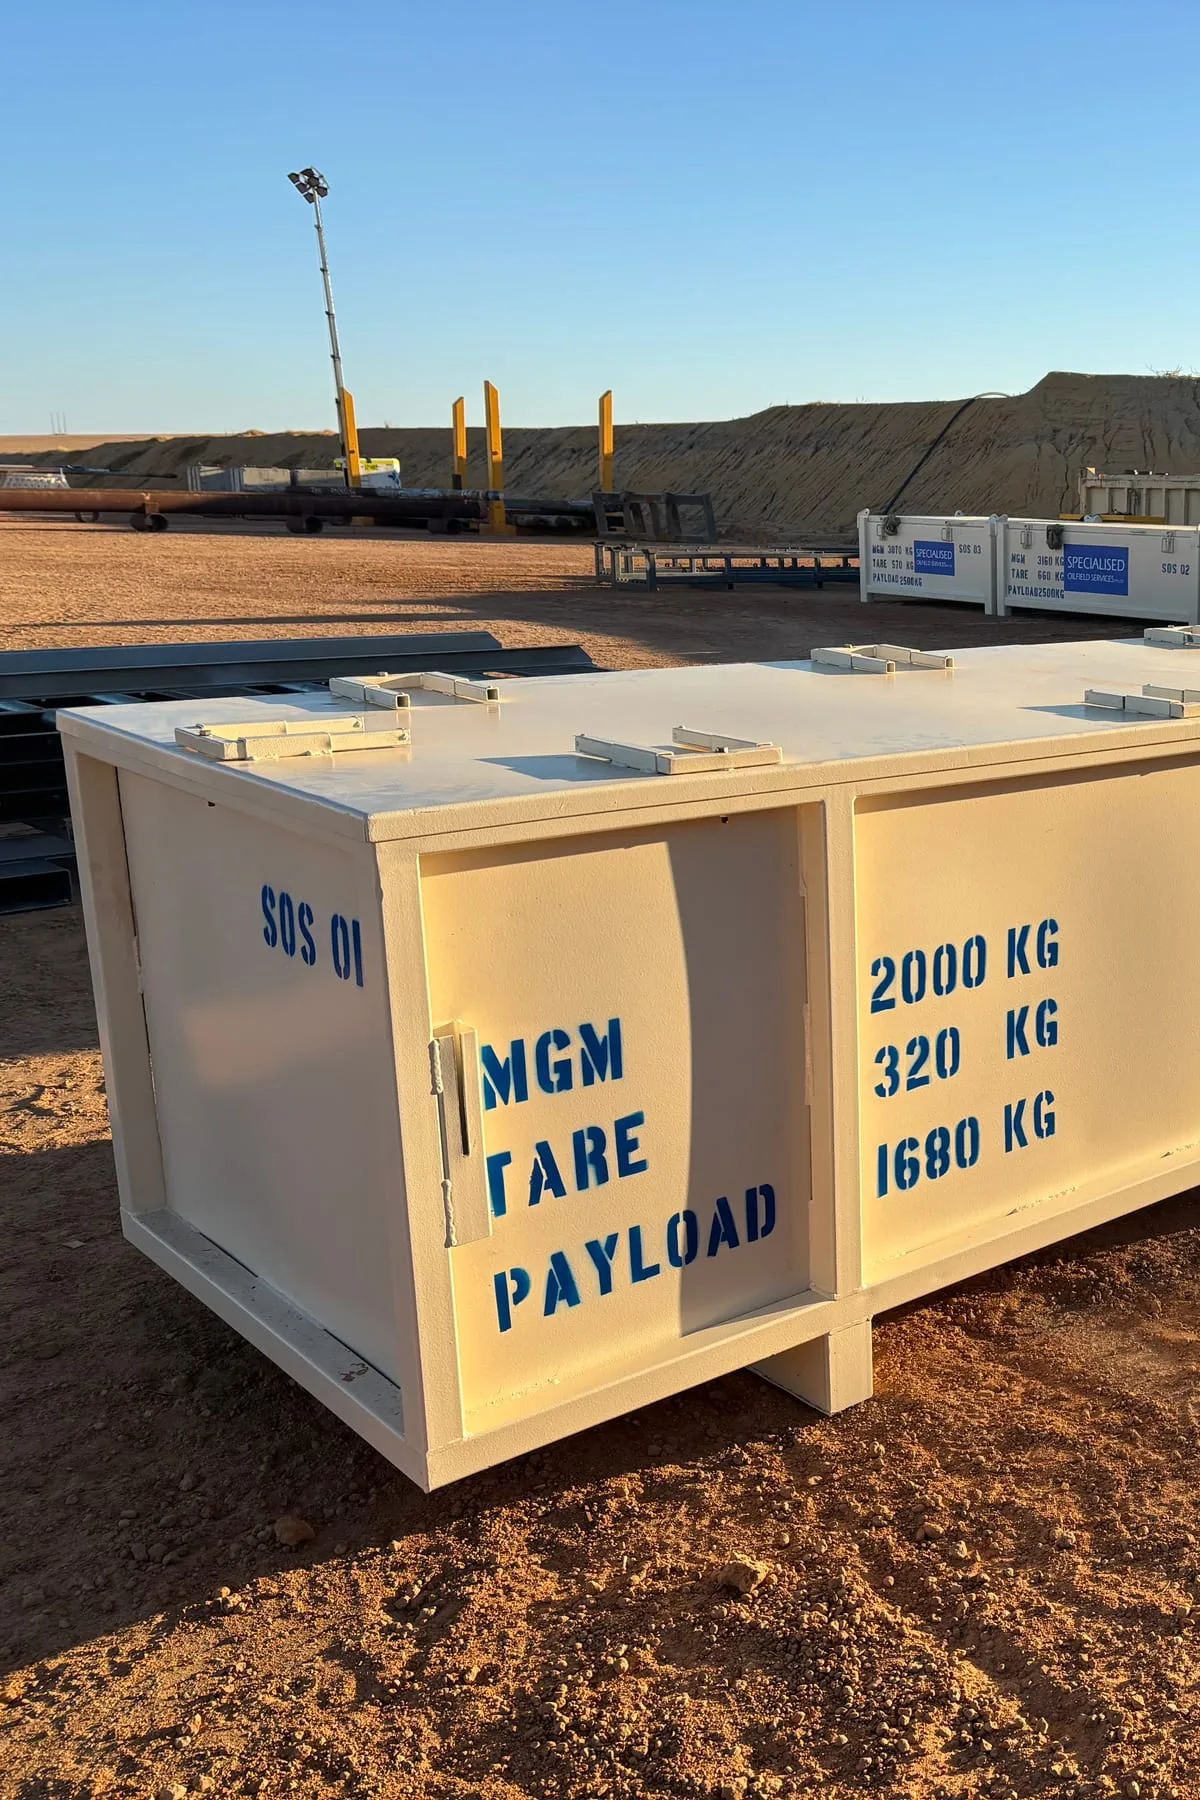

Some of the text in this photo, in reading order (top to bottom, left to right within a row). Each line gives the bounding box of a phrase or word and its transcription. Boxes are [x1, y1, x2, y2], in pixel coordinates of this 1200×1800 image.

[872, 545, 884, 554] MGM
[905, 547, 913, 556] KG
[916, 548, 953, 560] SPECIALISED
[959, 544, 982, 554] SOS 03
[873, 559, 887, 569] TARE
[906, 561, 914, 570] KG
[1011, 553, 1064, 566] MGM 3160 KG
[1067, 555, 1125, 572] SPECIALISED
[1011, 568, 1029, 580] TARE
[1055, 571, 1064, 581] KG
[1161, 563, 1190, 576] SOS 02
[873, 573, 899, 583] PAYLOAD
[1067, 572, 1091, 581] OILFIELD
[1091, 573, 1114, 583] SERVICES
[1008, 584, 1038, 598] PAYLOAD
[261, 884, 364, 988] SOS 01
[480, 918, 1059, 1111] MGM 2000 KG
[486, 998, 1058, 1218] TARE 320 KG
[493, 1090, 1056, 1334] PAYLOAD 1680 KG
